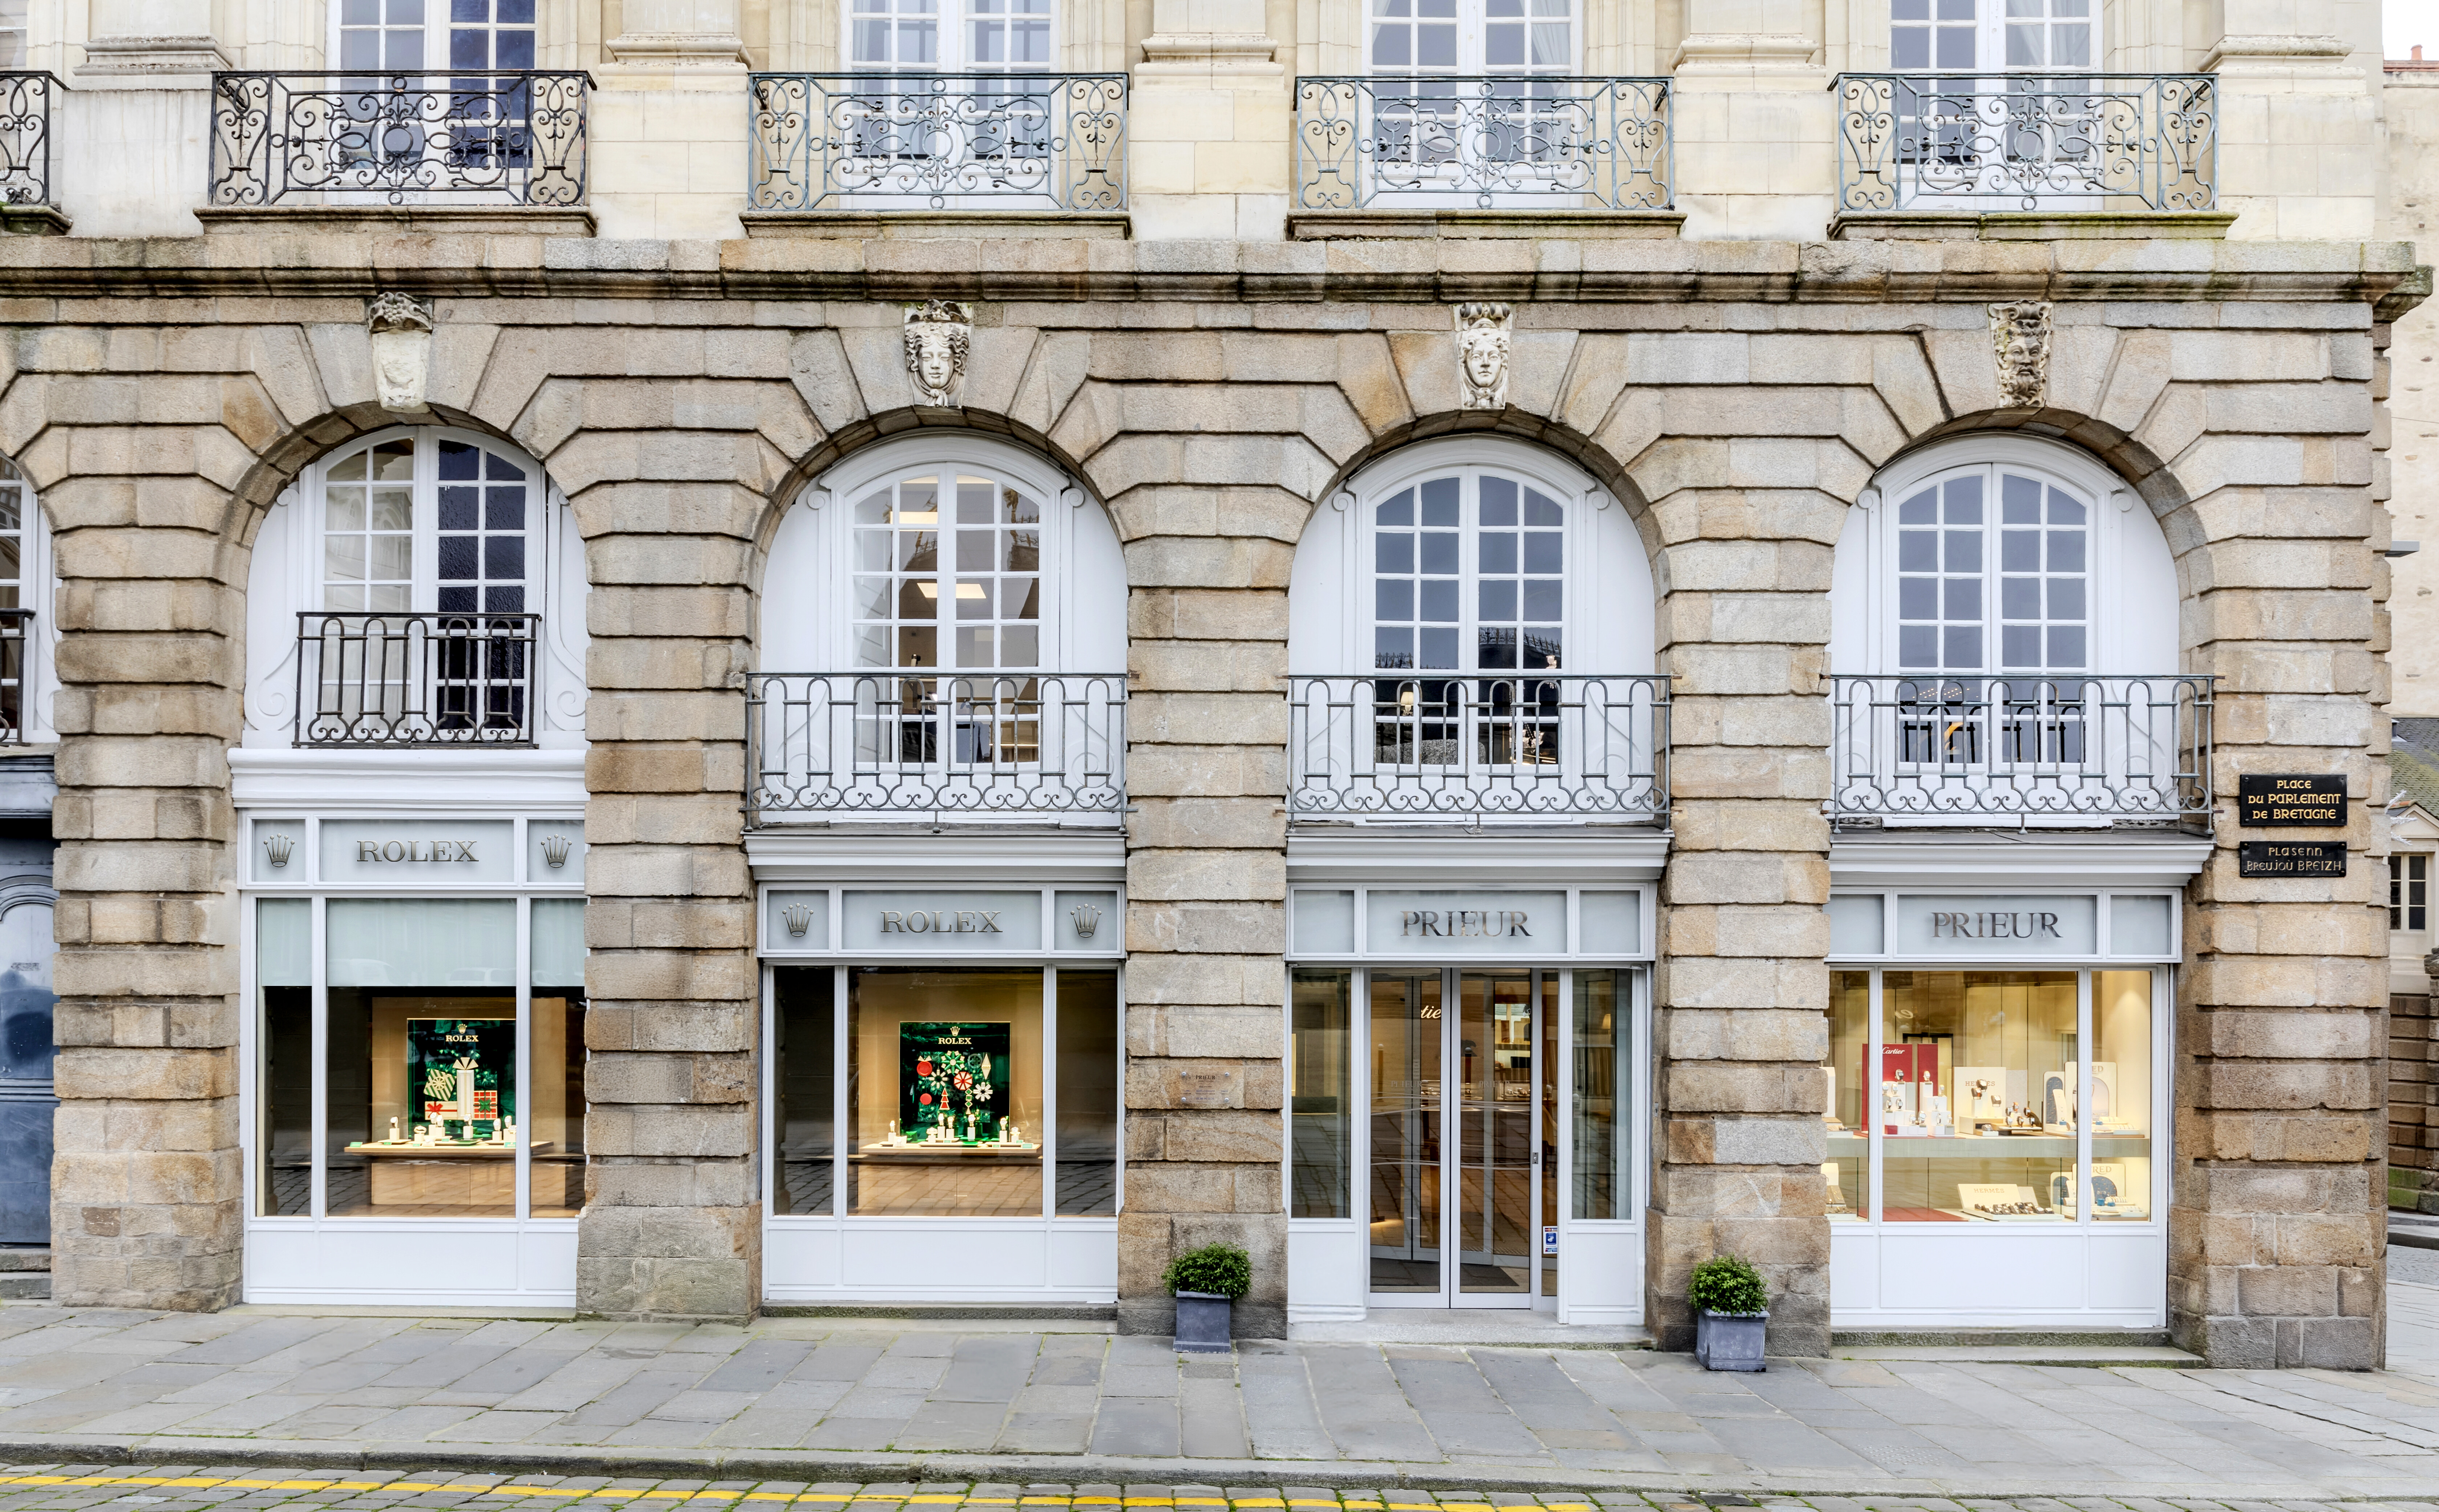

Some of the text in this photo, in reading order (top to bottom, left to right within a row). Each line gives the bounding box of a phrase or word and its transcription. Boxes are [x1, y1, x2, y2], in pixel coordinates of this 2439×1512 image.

[2277, 780, 2311, 789] PLACE
[2248, 793, 2341, 804] DU PARLEMENT
[2252, 809, 2336, 819] DE BRETAGNE
[357, 840, 479, 862] ROLEX
[2268, 847, 2322, 856] PLASENN
[2298, 861, 2341, 871] BREIZH
[881, 910, 1003, 933] ROLEX
[1400, 911, 1533, 937] PRIEUR
[1930, 912, 2064, 938] PRIEUR
[2092, 1166, 2112, 1175] RED
